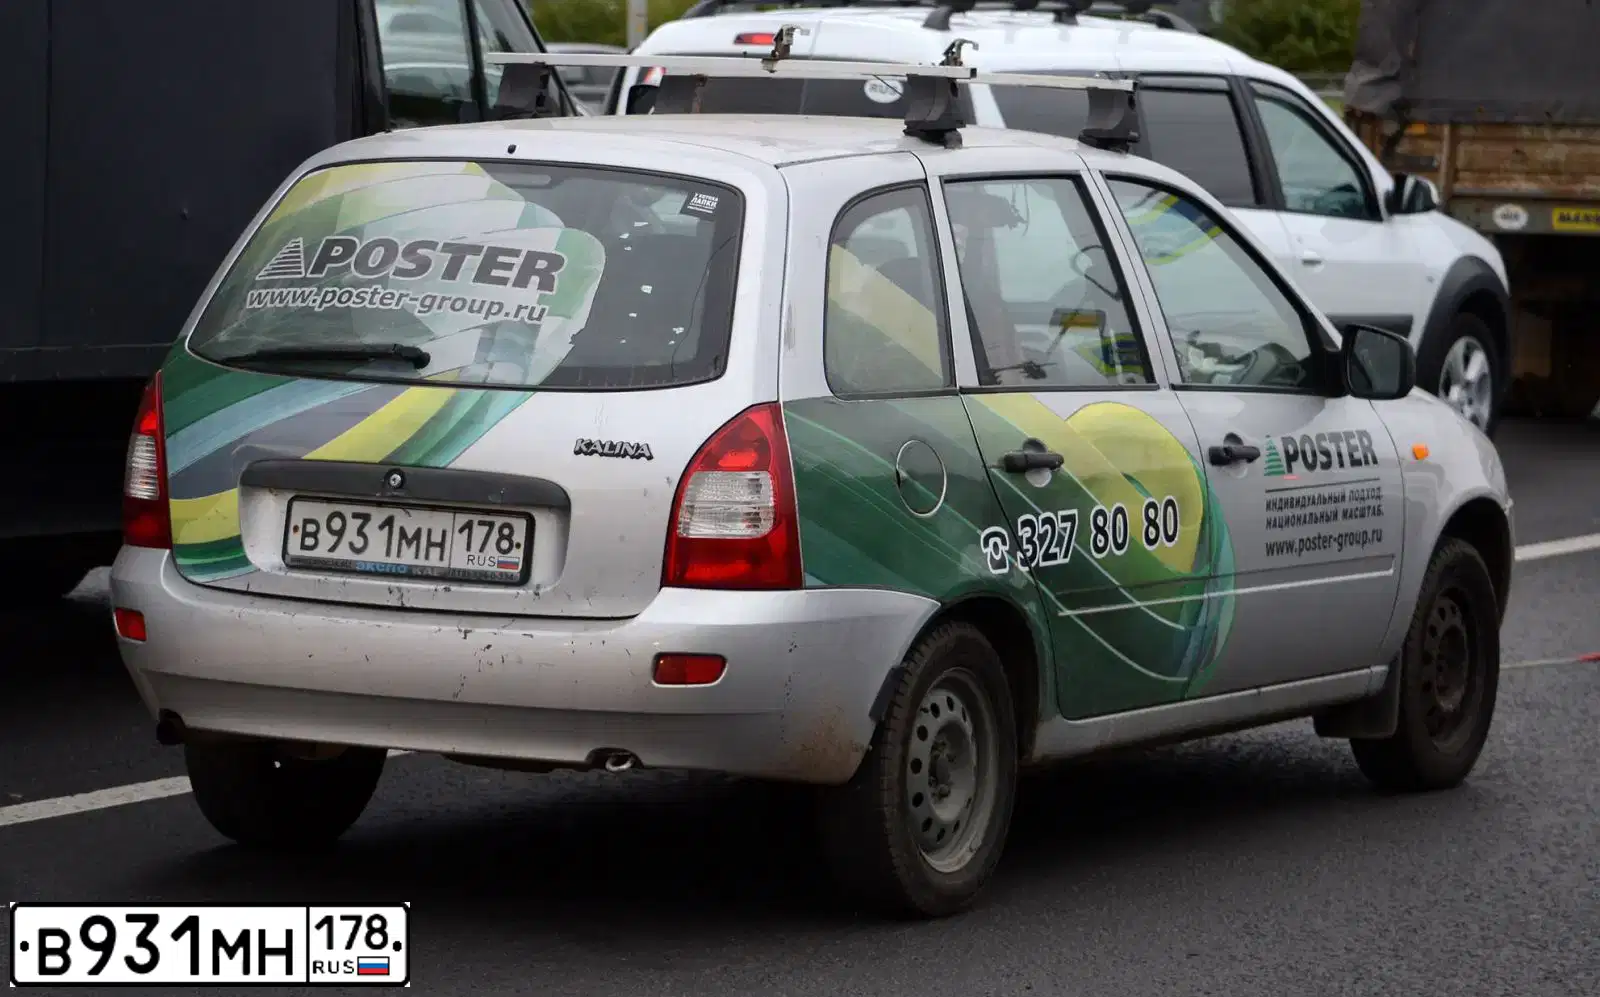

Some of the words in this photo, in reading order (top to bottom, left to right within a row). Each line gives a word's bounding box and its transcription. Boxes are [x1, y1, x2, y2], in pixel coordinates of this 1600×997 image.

[306, 236, 567, 294] POSTER
[247, 286, 549, 325] www.poster-group.ru
[573, 438, 654, 461] KALINA
[1281, 430, 1379, 474] POSTER
[1265, 489, 1346, 513] ИНДИВИДУАЛЬНЫЙ
[1017, 509, 1079, 572] 327
[1090, 502, 1129, 559] 80
[1142, 495, 1179, 551] 80
[1265, 507, 1338, 531] НАЦИОНАЛЬНЫЙ
[300, 511, 447, 562] В931МН
[458, 519, 515, 555] 178
[1265, 528, 1384, 558] www.poster-group.ru
[466, 554, 496, 567] RUS
